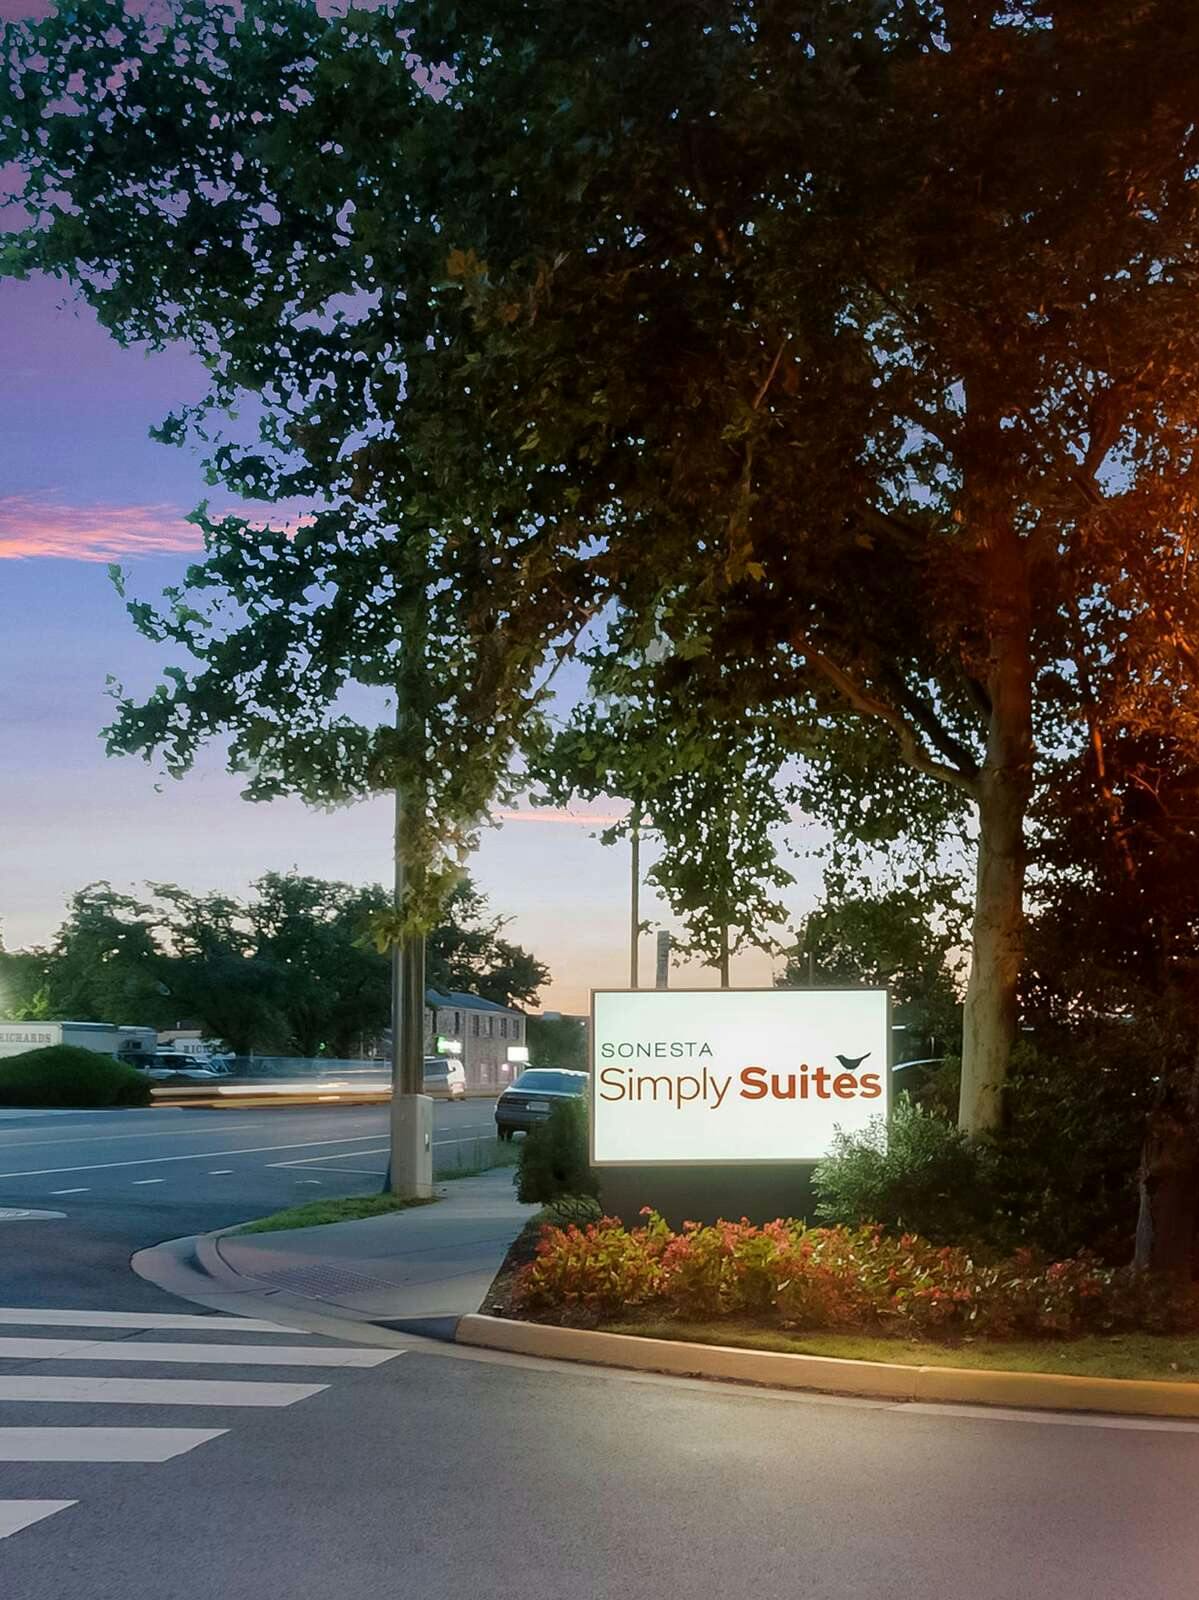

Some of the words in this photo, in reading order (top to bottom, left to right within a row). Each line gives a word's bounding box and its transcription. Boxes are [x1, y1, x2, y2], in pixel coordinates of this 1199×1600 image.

[600, 1042, 713, 1058] SONESTA
[600, 1066, 732, 1110] Simply
[739, 1063, 882, 1101] Suites
